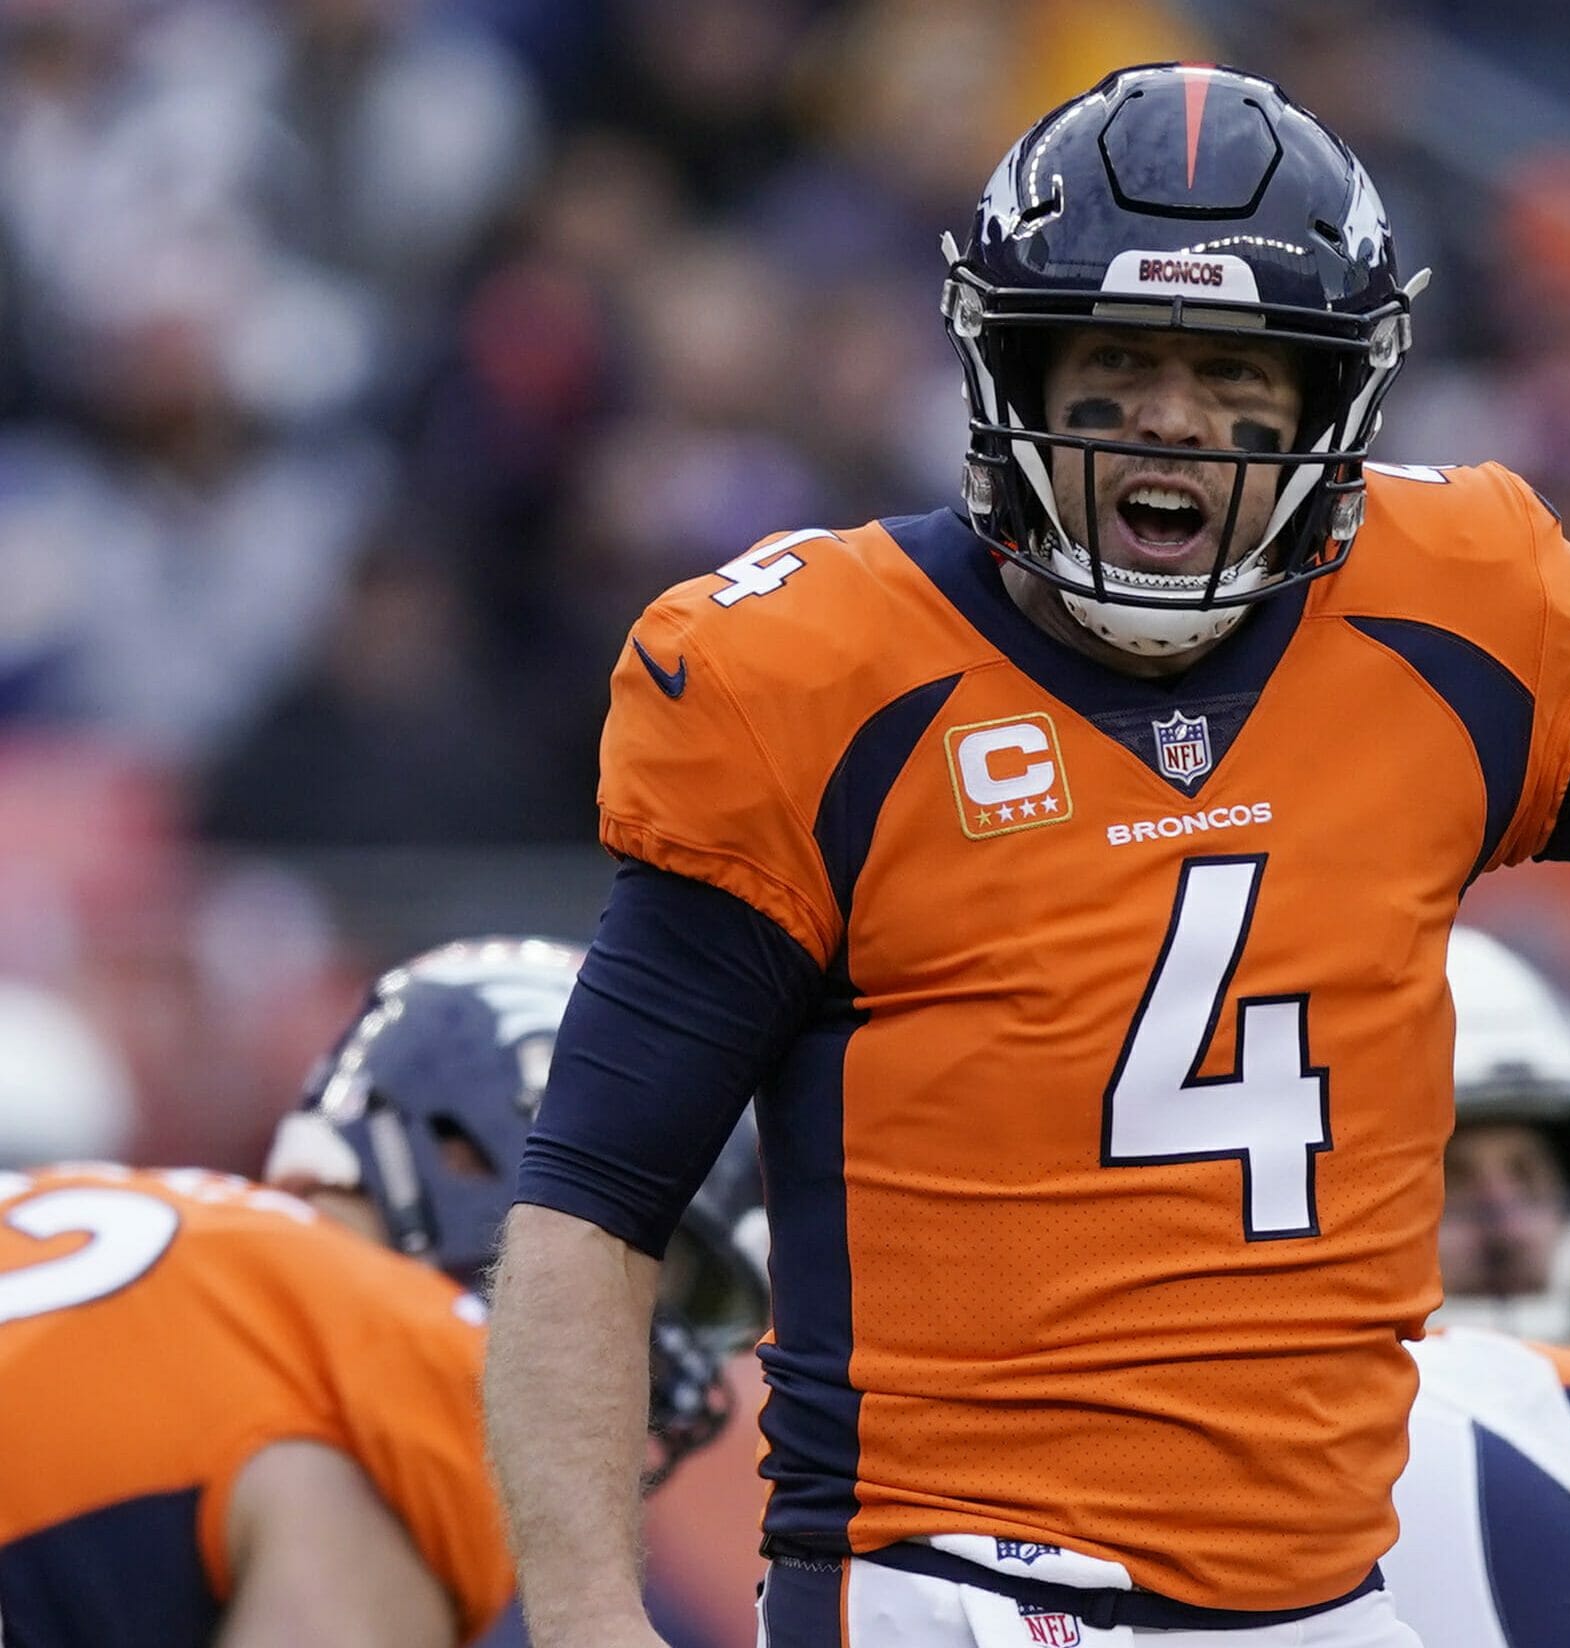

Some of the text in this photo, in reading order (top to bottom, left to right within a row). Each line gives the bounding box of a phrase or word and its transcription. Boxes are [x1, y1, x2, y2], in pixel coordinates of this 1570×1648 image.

[1139, 258, 1224, 287] BRONCOS
[709, 528, 846, 608] 4
[958, 723, 1056, 806] C
[1166, 744, 1205, 772] NFL
[1107, 802, 1273, 846] BRONCOS
[1101, 852, 1334, 1242] 4
[1024, 1614, 1075, 1648] NFL
